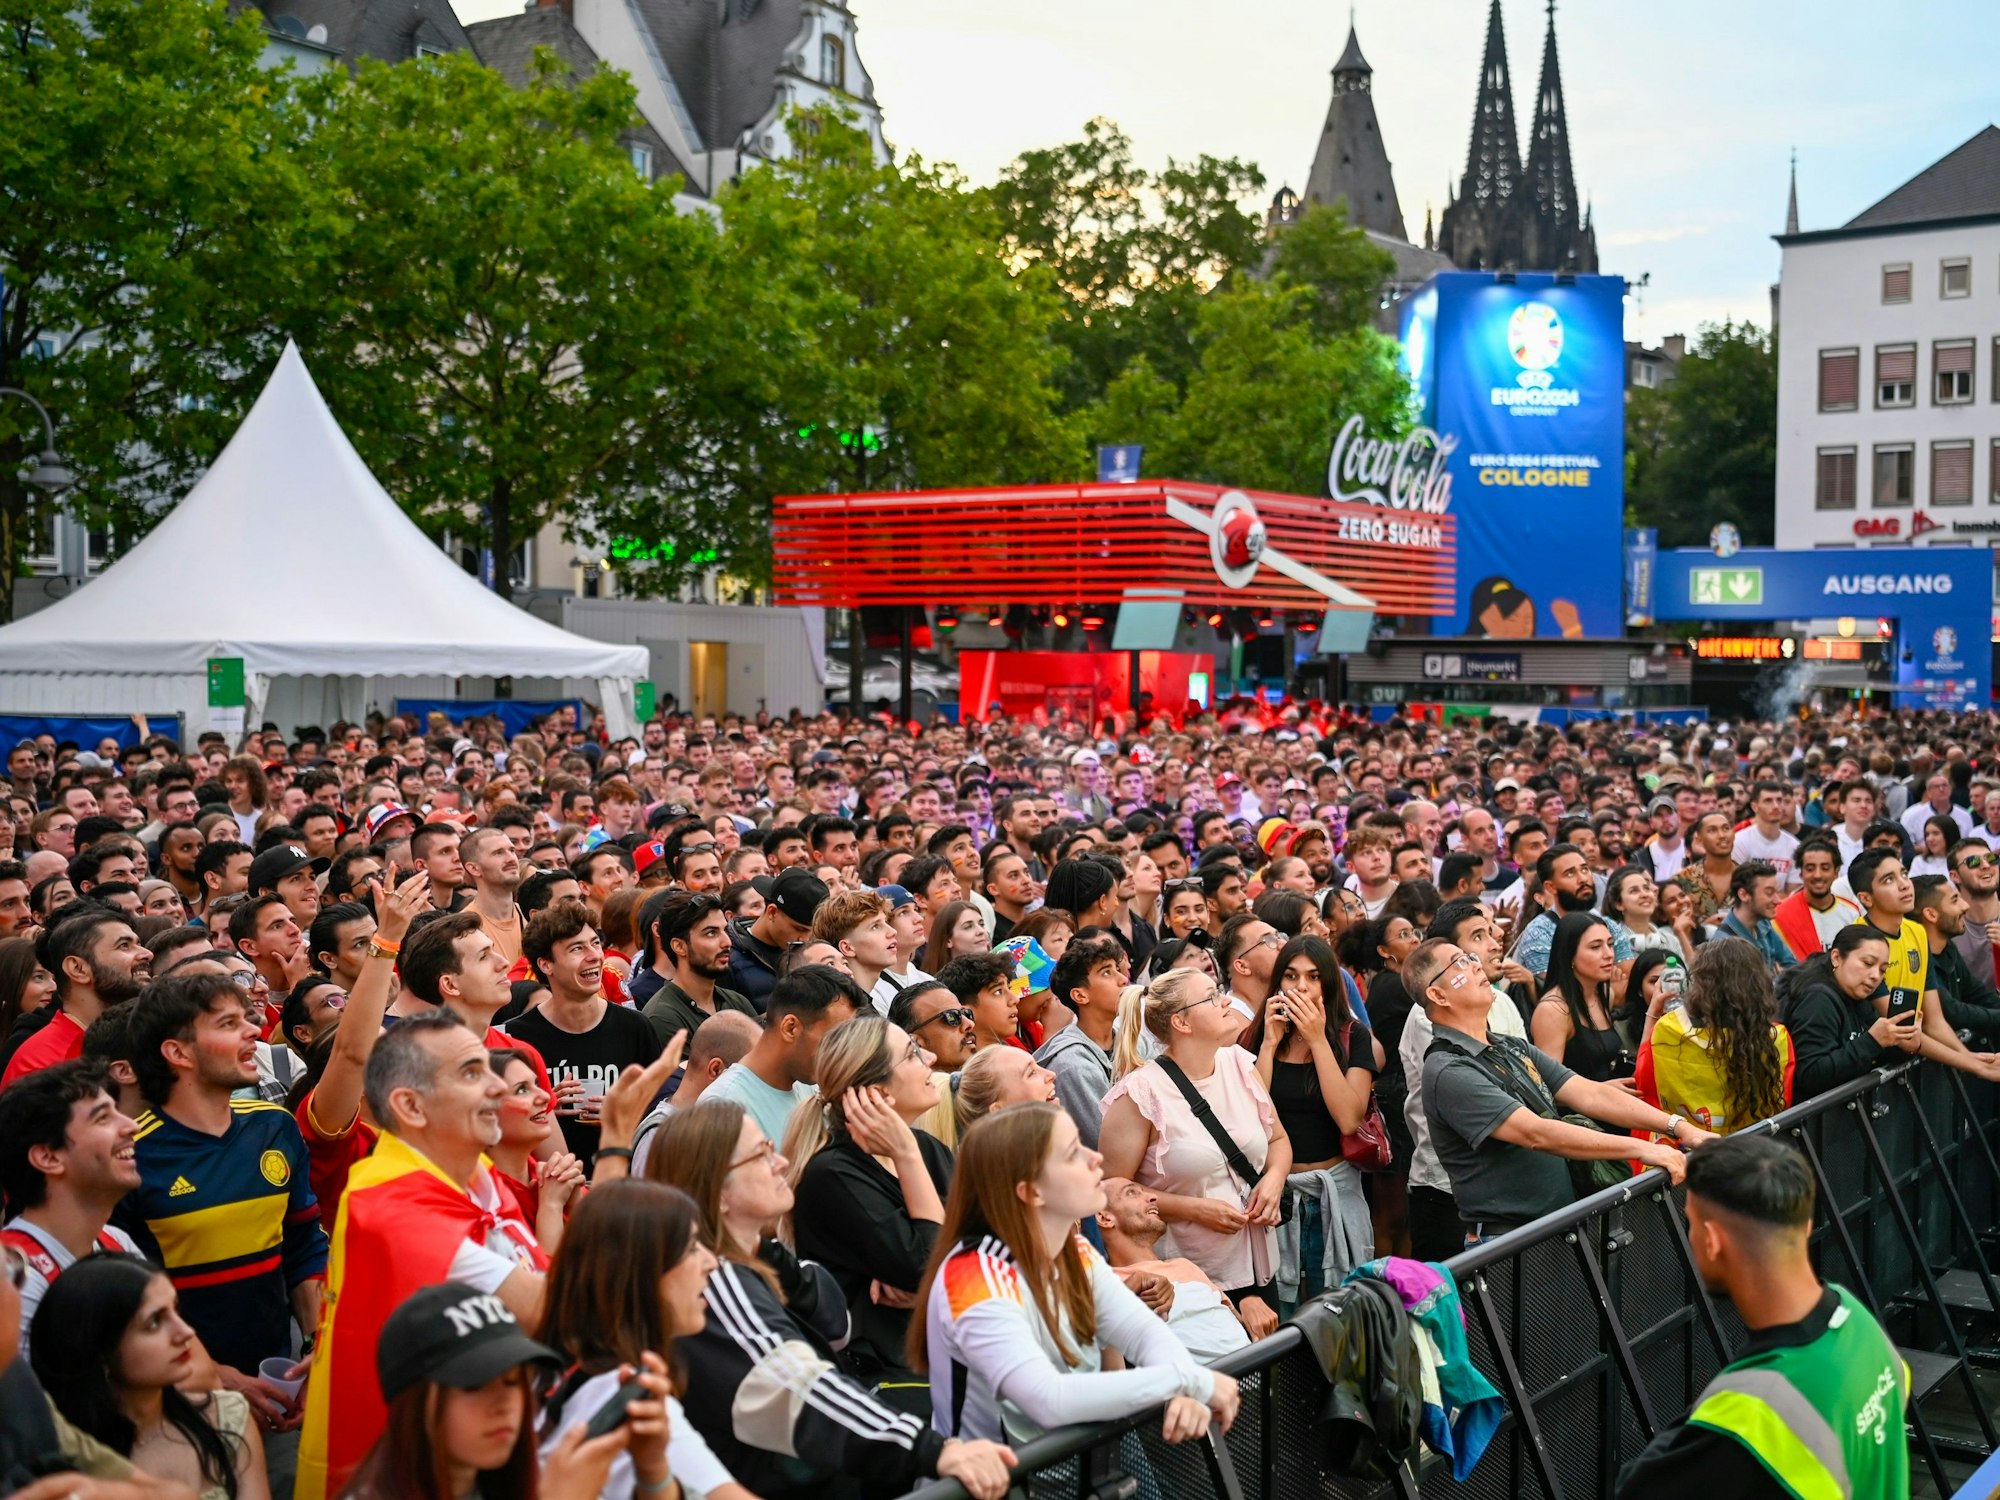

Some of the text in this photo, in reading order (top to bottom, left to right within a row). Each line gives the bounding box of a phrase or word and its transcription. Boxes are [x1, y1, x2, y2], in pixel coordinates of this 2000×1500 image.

[1469, 454, 1601, 468] EURO 2024 FESTIVAL
[1478, 468, 1590, 487] COLOGNE
[1338, 516, 1442, 548] ZERO SUGAR
[1853, 517, 1900, 538] GAG
[1823, 574, 1953, 595] AUSGANG
[169, 1185, 197, 1197] adidas
